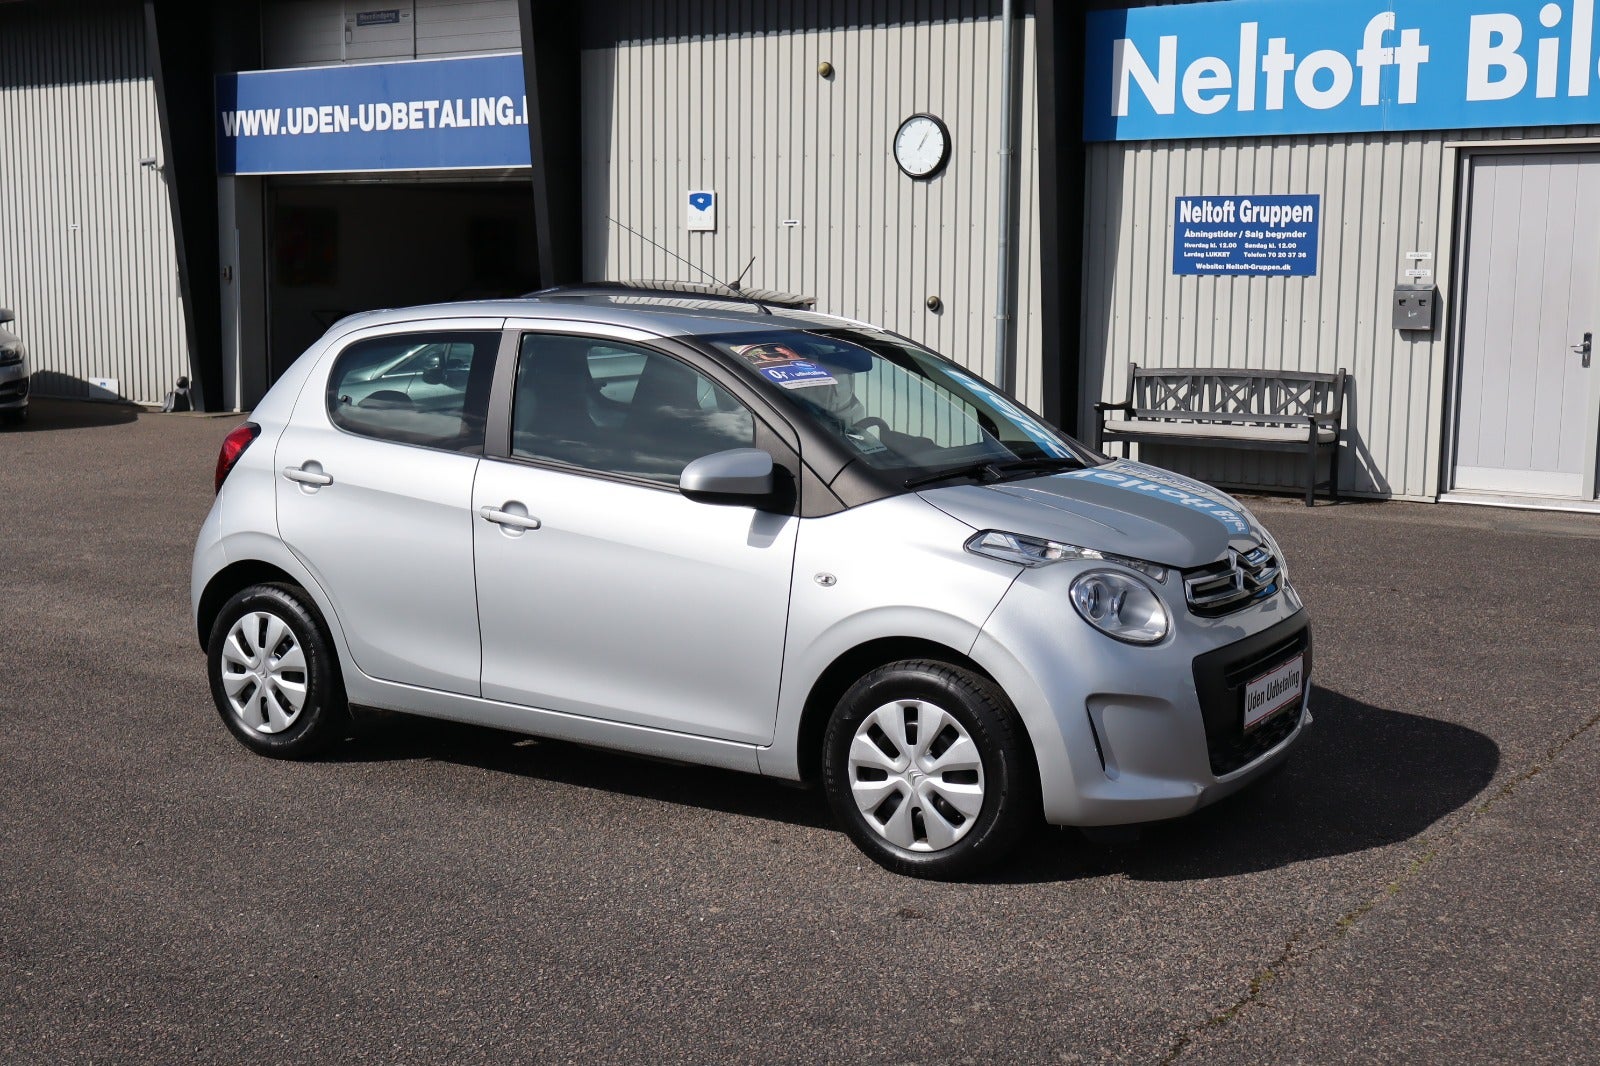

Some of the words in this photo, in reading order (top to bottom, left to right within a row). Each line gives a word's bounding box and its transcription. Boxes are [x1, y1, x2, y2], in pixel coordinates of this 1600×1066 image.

[1111, 11, 1430, 117] Neltoft
[1466, 0, 1600, 101] Bil
[1179, 200, 1235, 223] Neltoft
[1239, 200, 1313, 228] Gruppen
[1184, 228, 1237, 239] Åbningstider
[1244, 230, 1264, 239] Salg
[1265, 230, 1307, 239] begynder
[1247, 690, 1265, 713] Uden
[1266, 669, 1300, 701] Udbetaling
